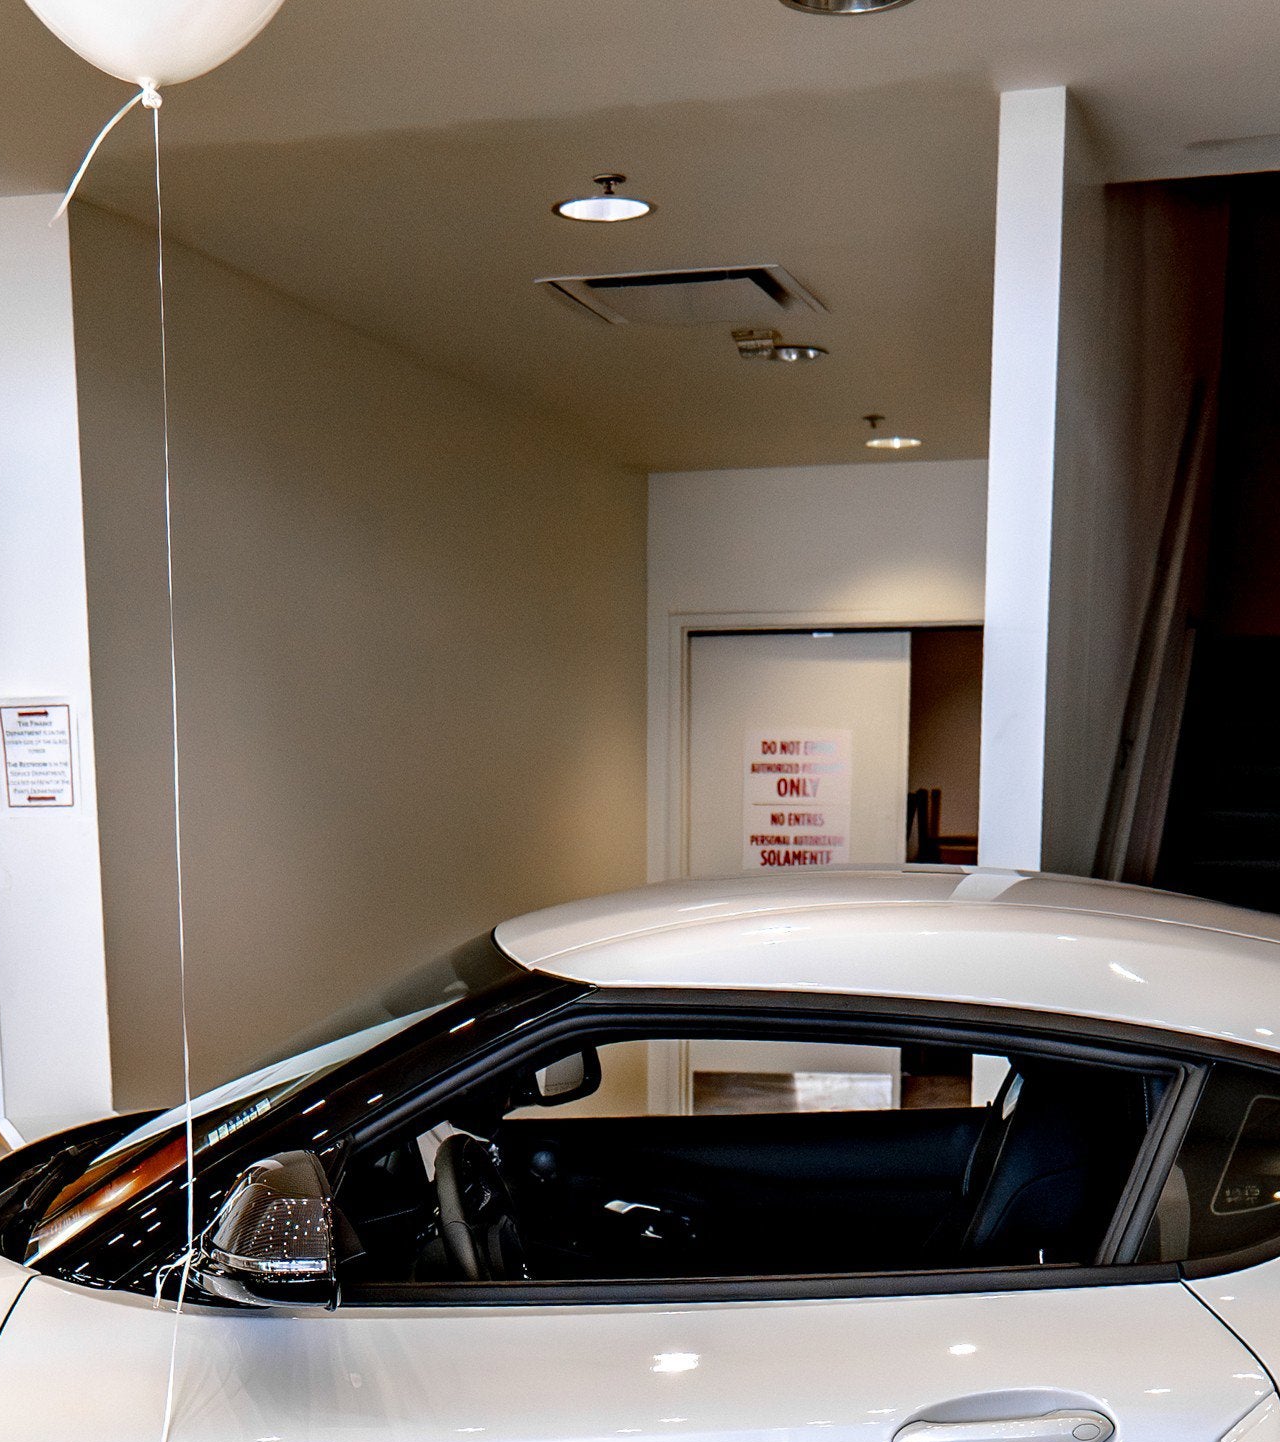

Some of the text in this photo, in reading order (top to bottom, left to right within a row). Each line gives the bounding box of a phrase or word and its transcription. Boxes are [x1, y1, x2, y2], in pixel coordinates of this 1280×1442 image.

[761, 740, 777, 755] DO
[779, 740, 800, 755] NOT
[777, 778, 820, 797] ONLY
[770, 812, 785, 826] NO
